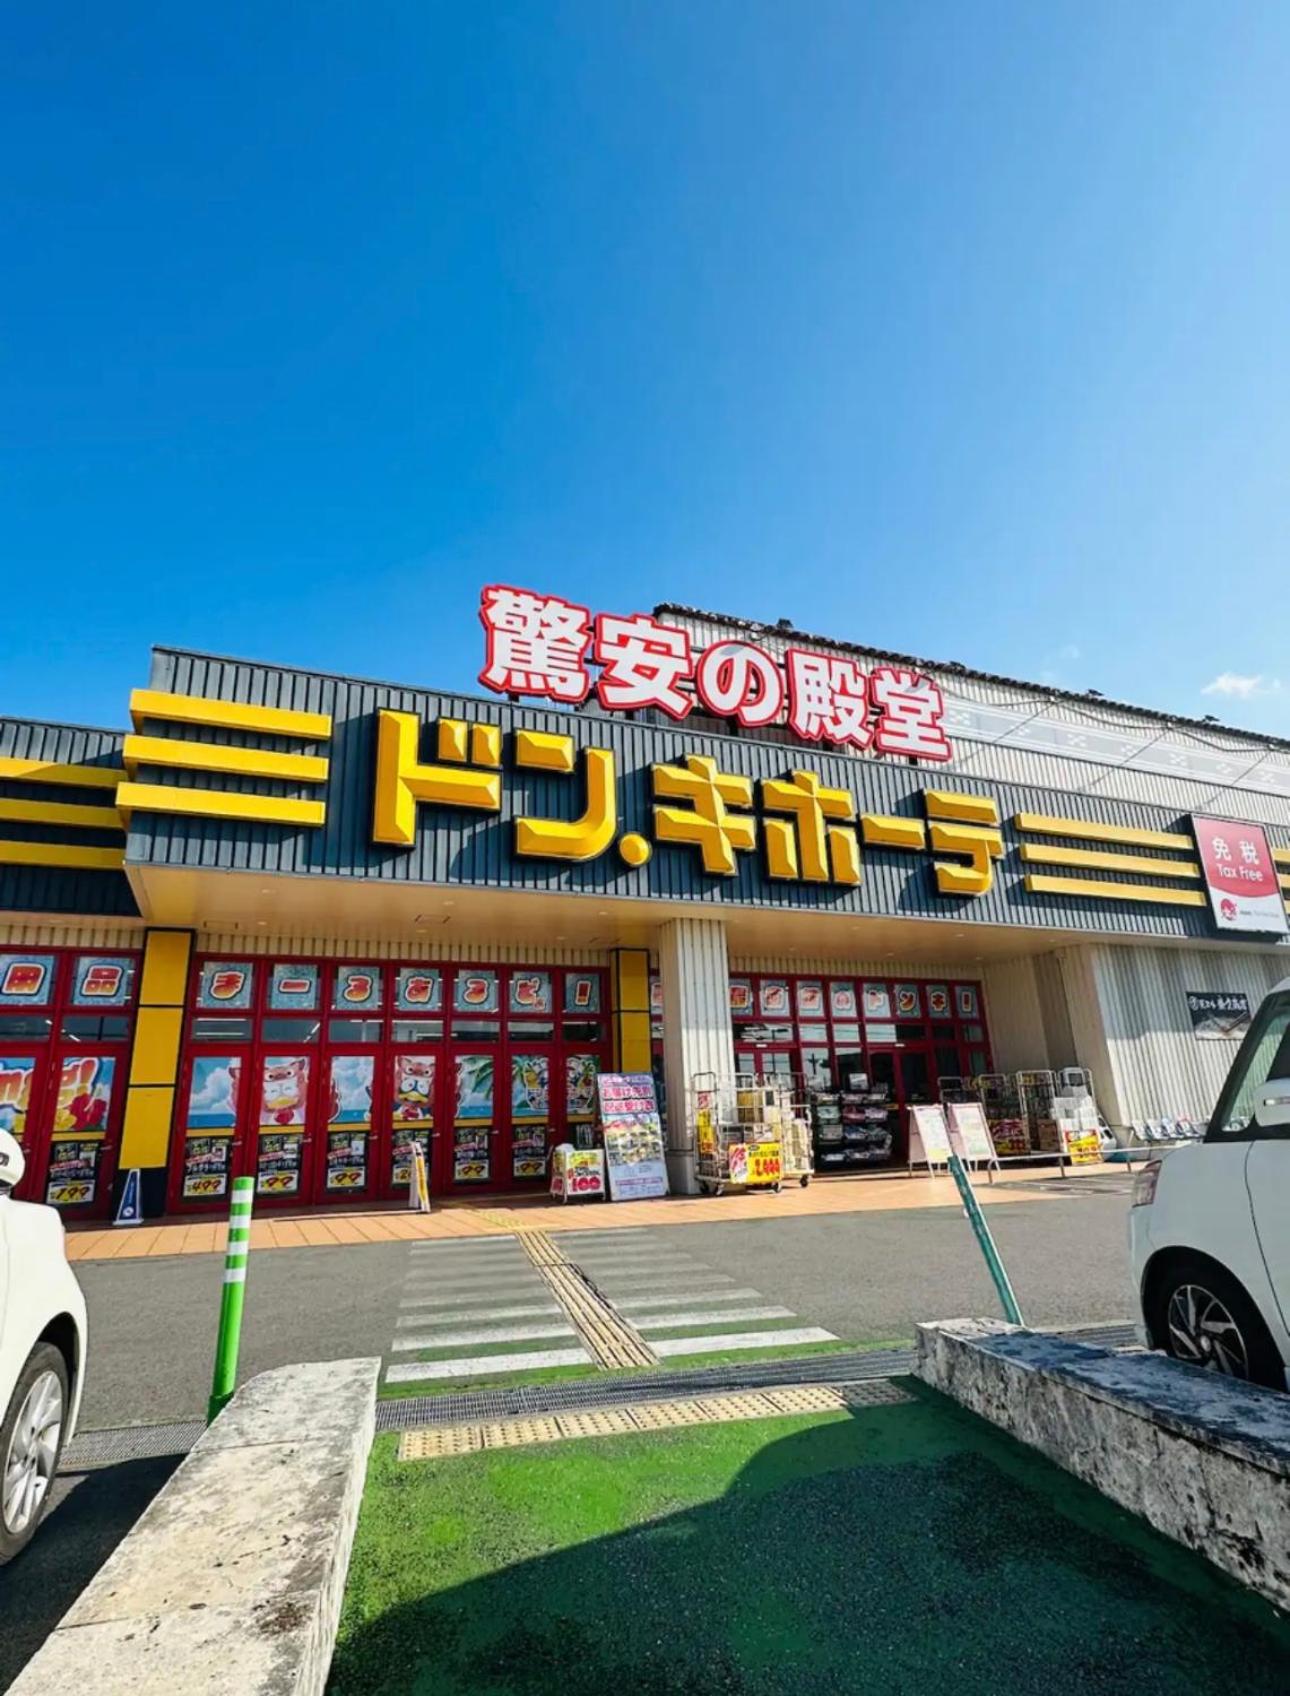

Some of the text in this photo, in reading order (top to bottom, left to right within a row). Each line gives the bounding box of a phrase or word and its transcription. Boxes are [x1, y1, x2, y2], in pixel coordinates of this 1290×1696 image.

[480, 585, 953, 761] 驚安の殿堂
[1216, 862, 1264, 882] Tax Free
